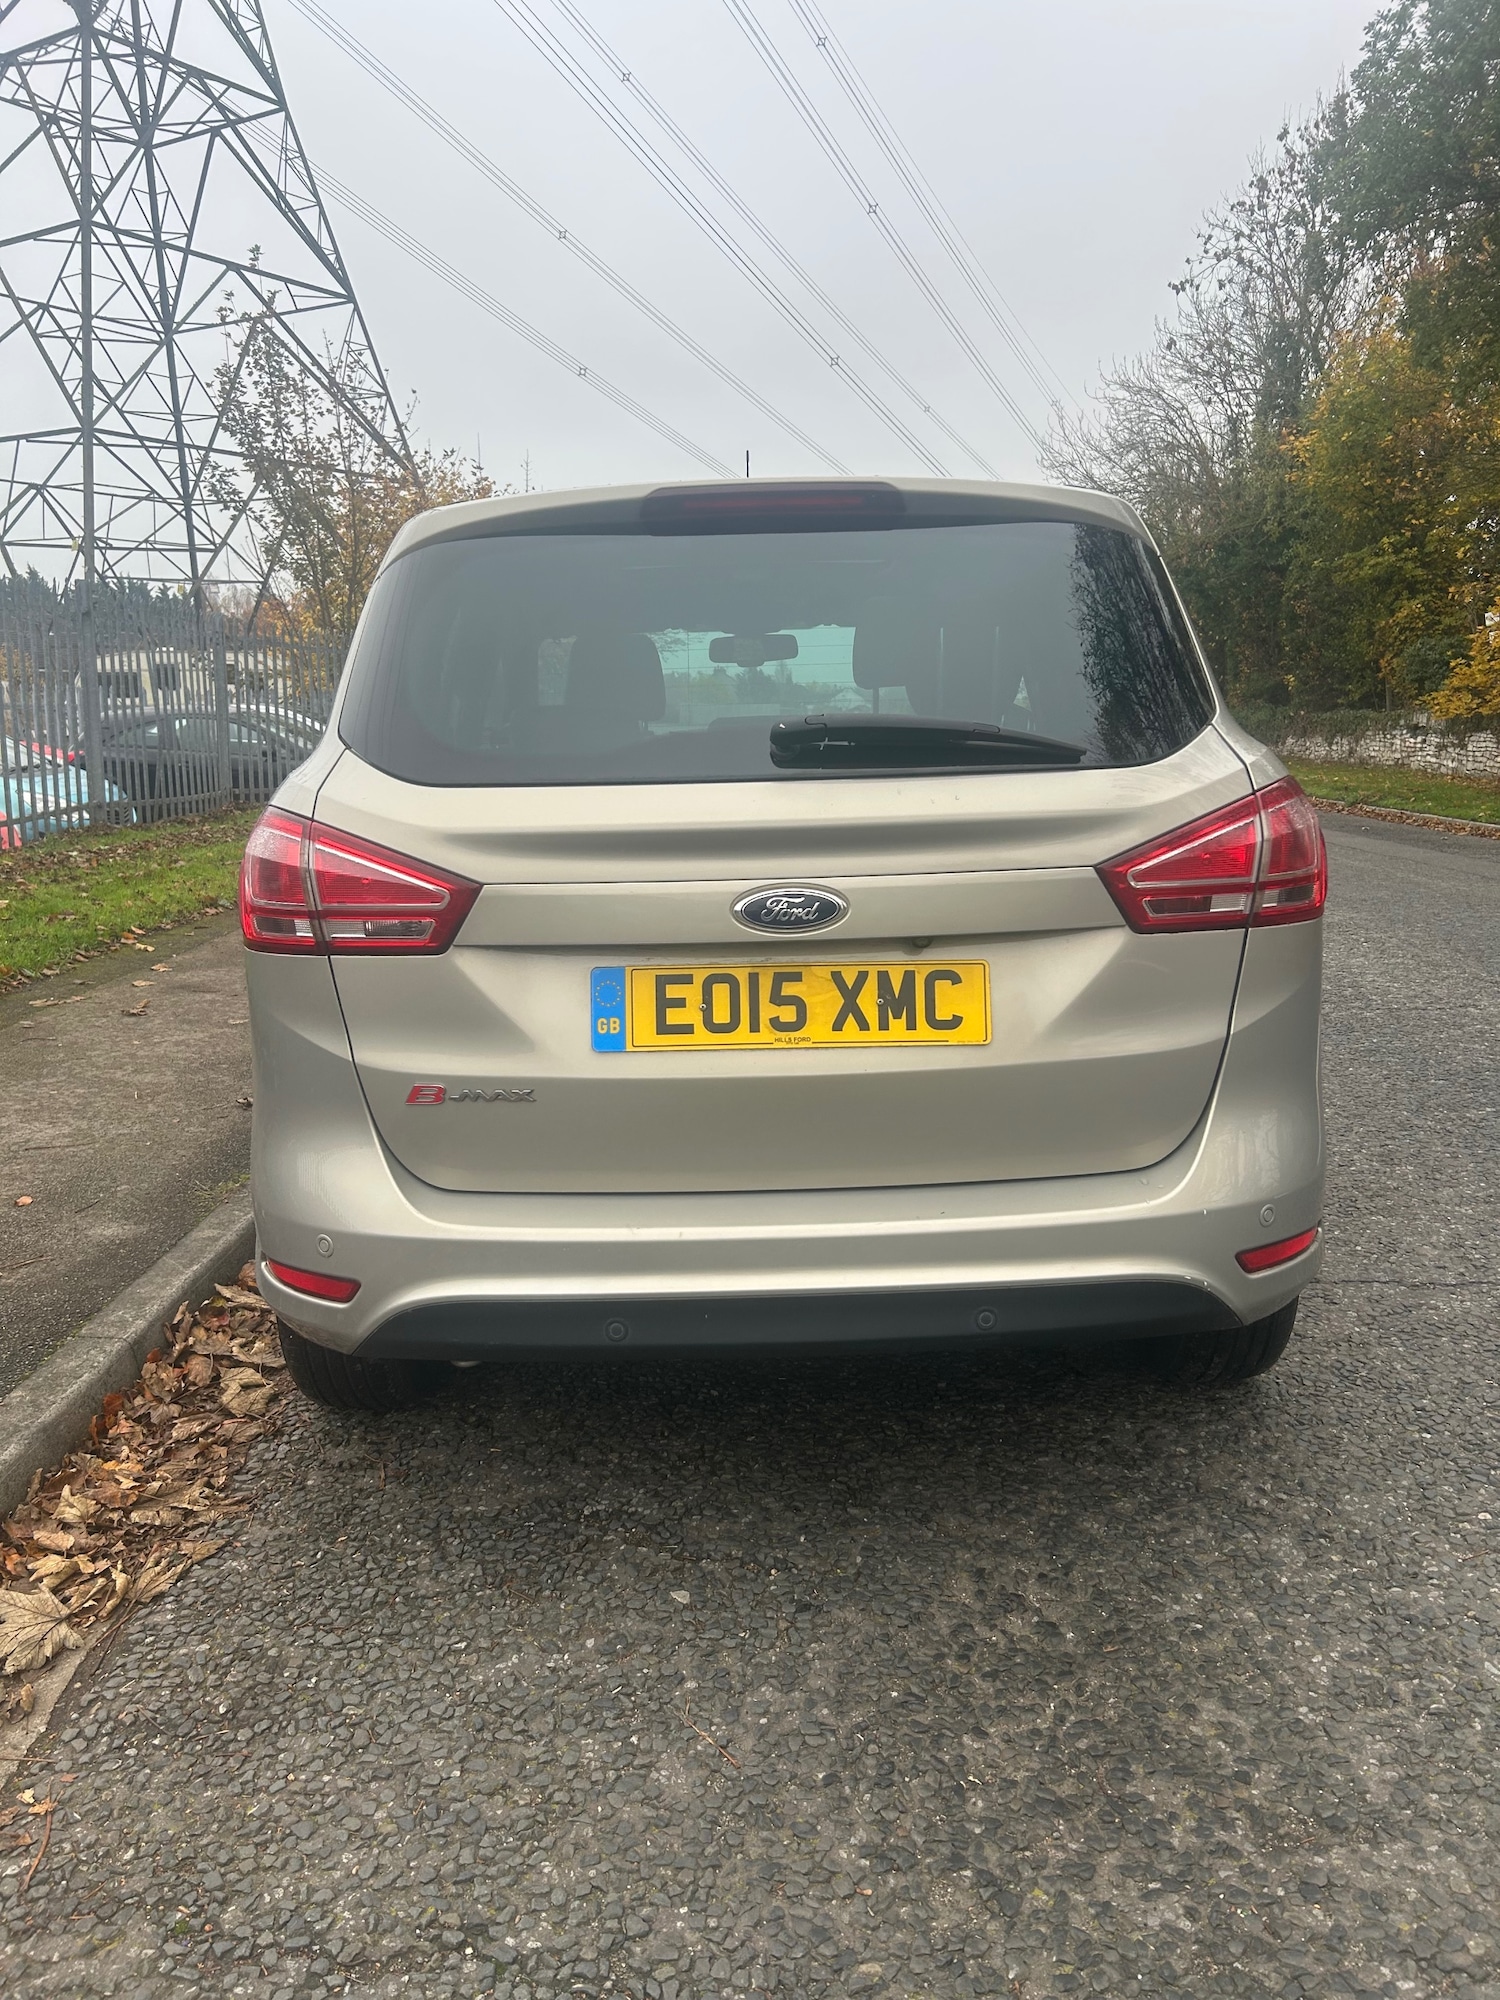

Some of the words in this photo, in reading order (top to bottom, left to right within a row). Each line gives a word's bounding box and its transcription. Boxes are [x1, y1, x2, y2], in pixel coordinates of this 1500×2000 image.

[761, 897, 820, 921] Ford
[655, 971, 807, 1035] EO15
[830, 969, 964, 1032] XMC
[597, 1017, 620, 1034] GB
[405, 1082, 537, 1105] B-MAX
